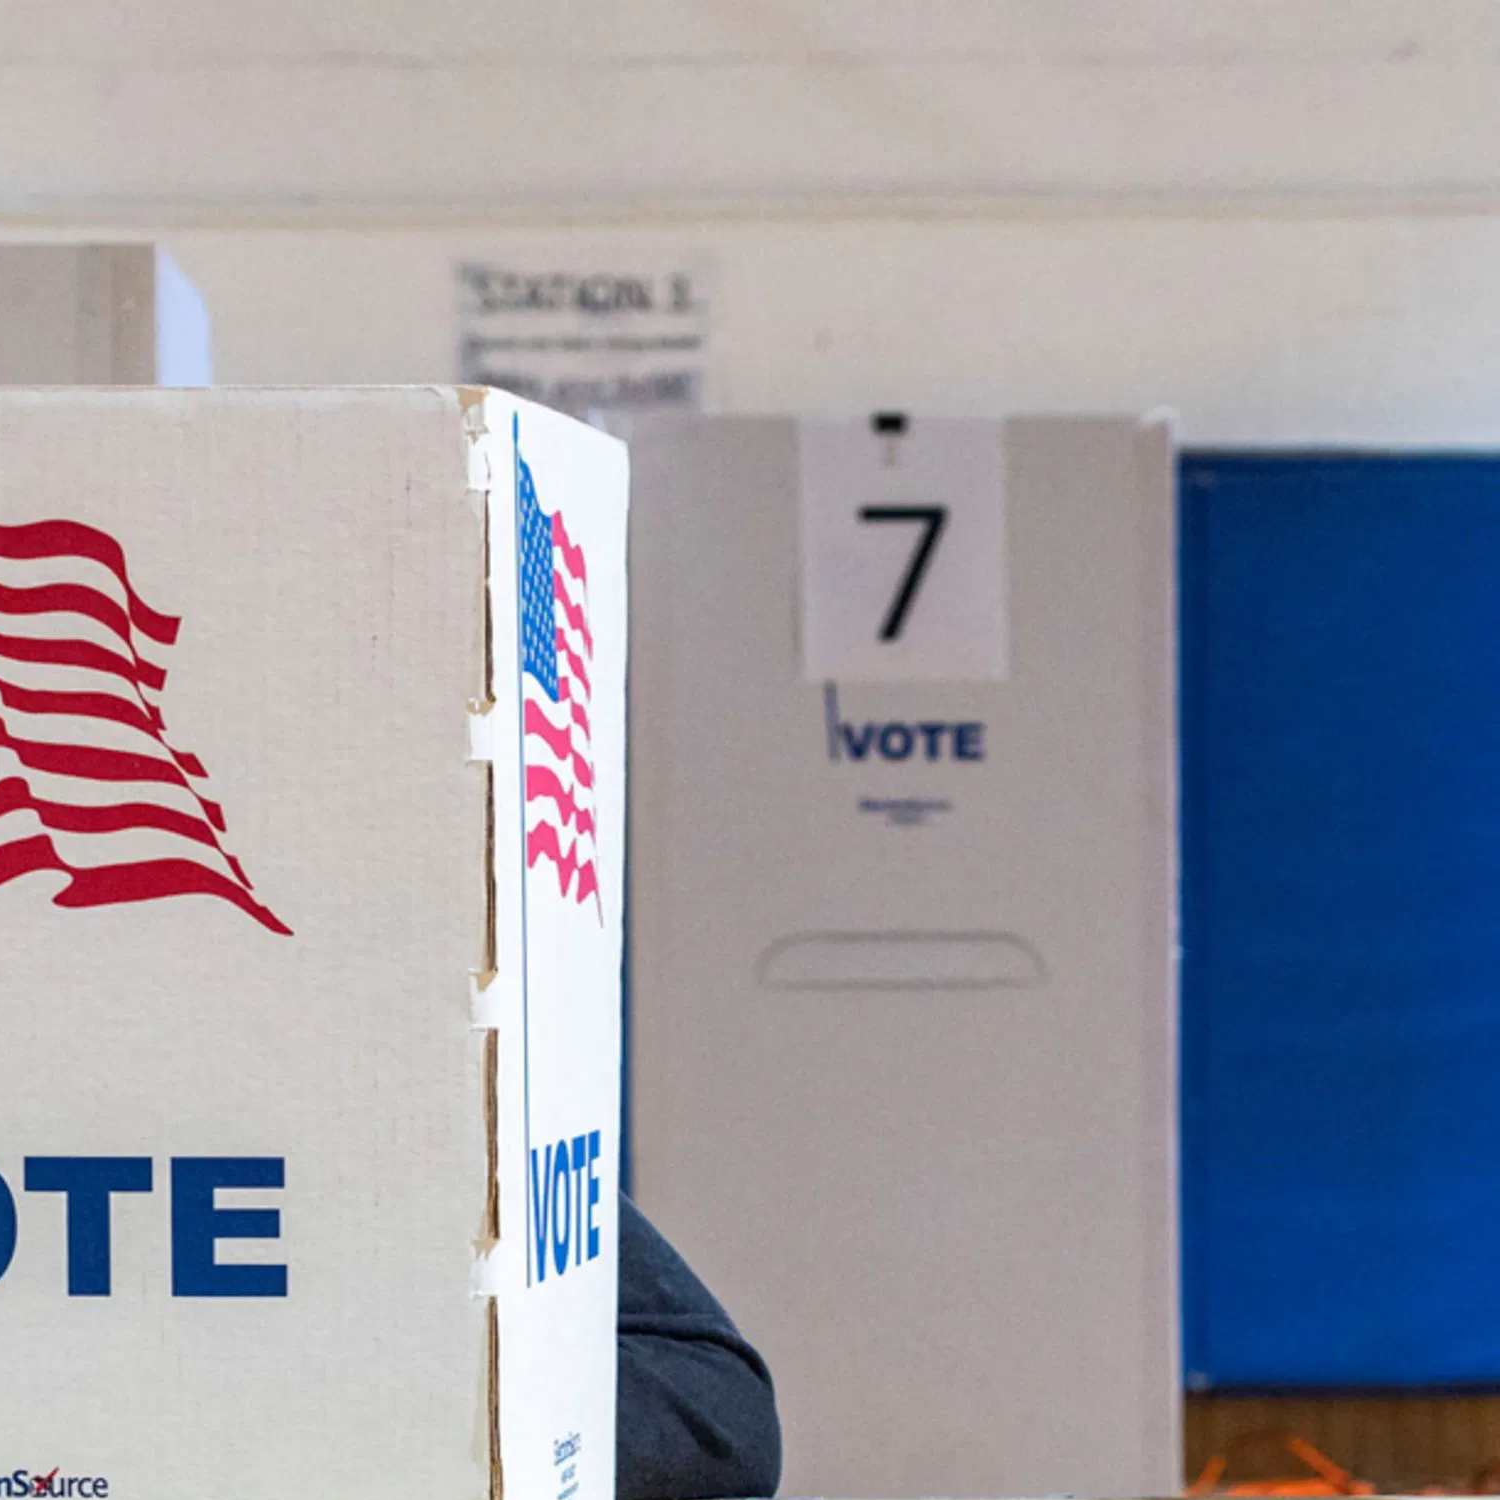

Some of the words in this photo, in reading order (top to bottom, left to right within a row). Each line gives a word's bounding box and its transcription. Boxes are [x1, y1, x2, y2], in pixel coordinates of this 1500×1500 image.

[857, 503, 950, 643] 7
[841, 722, 986, 763] VOTE
[531, 1130, 601, 1284] VOTE
